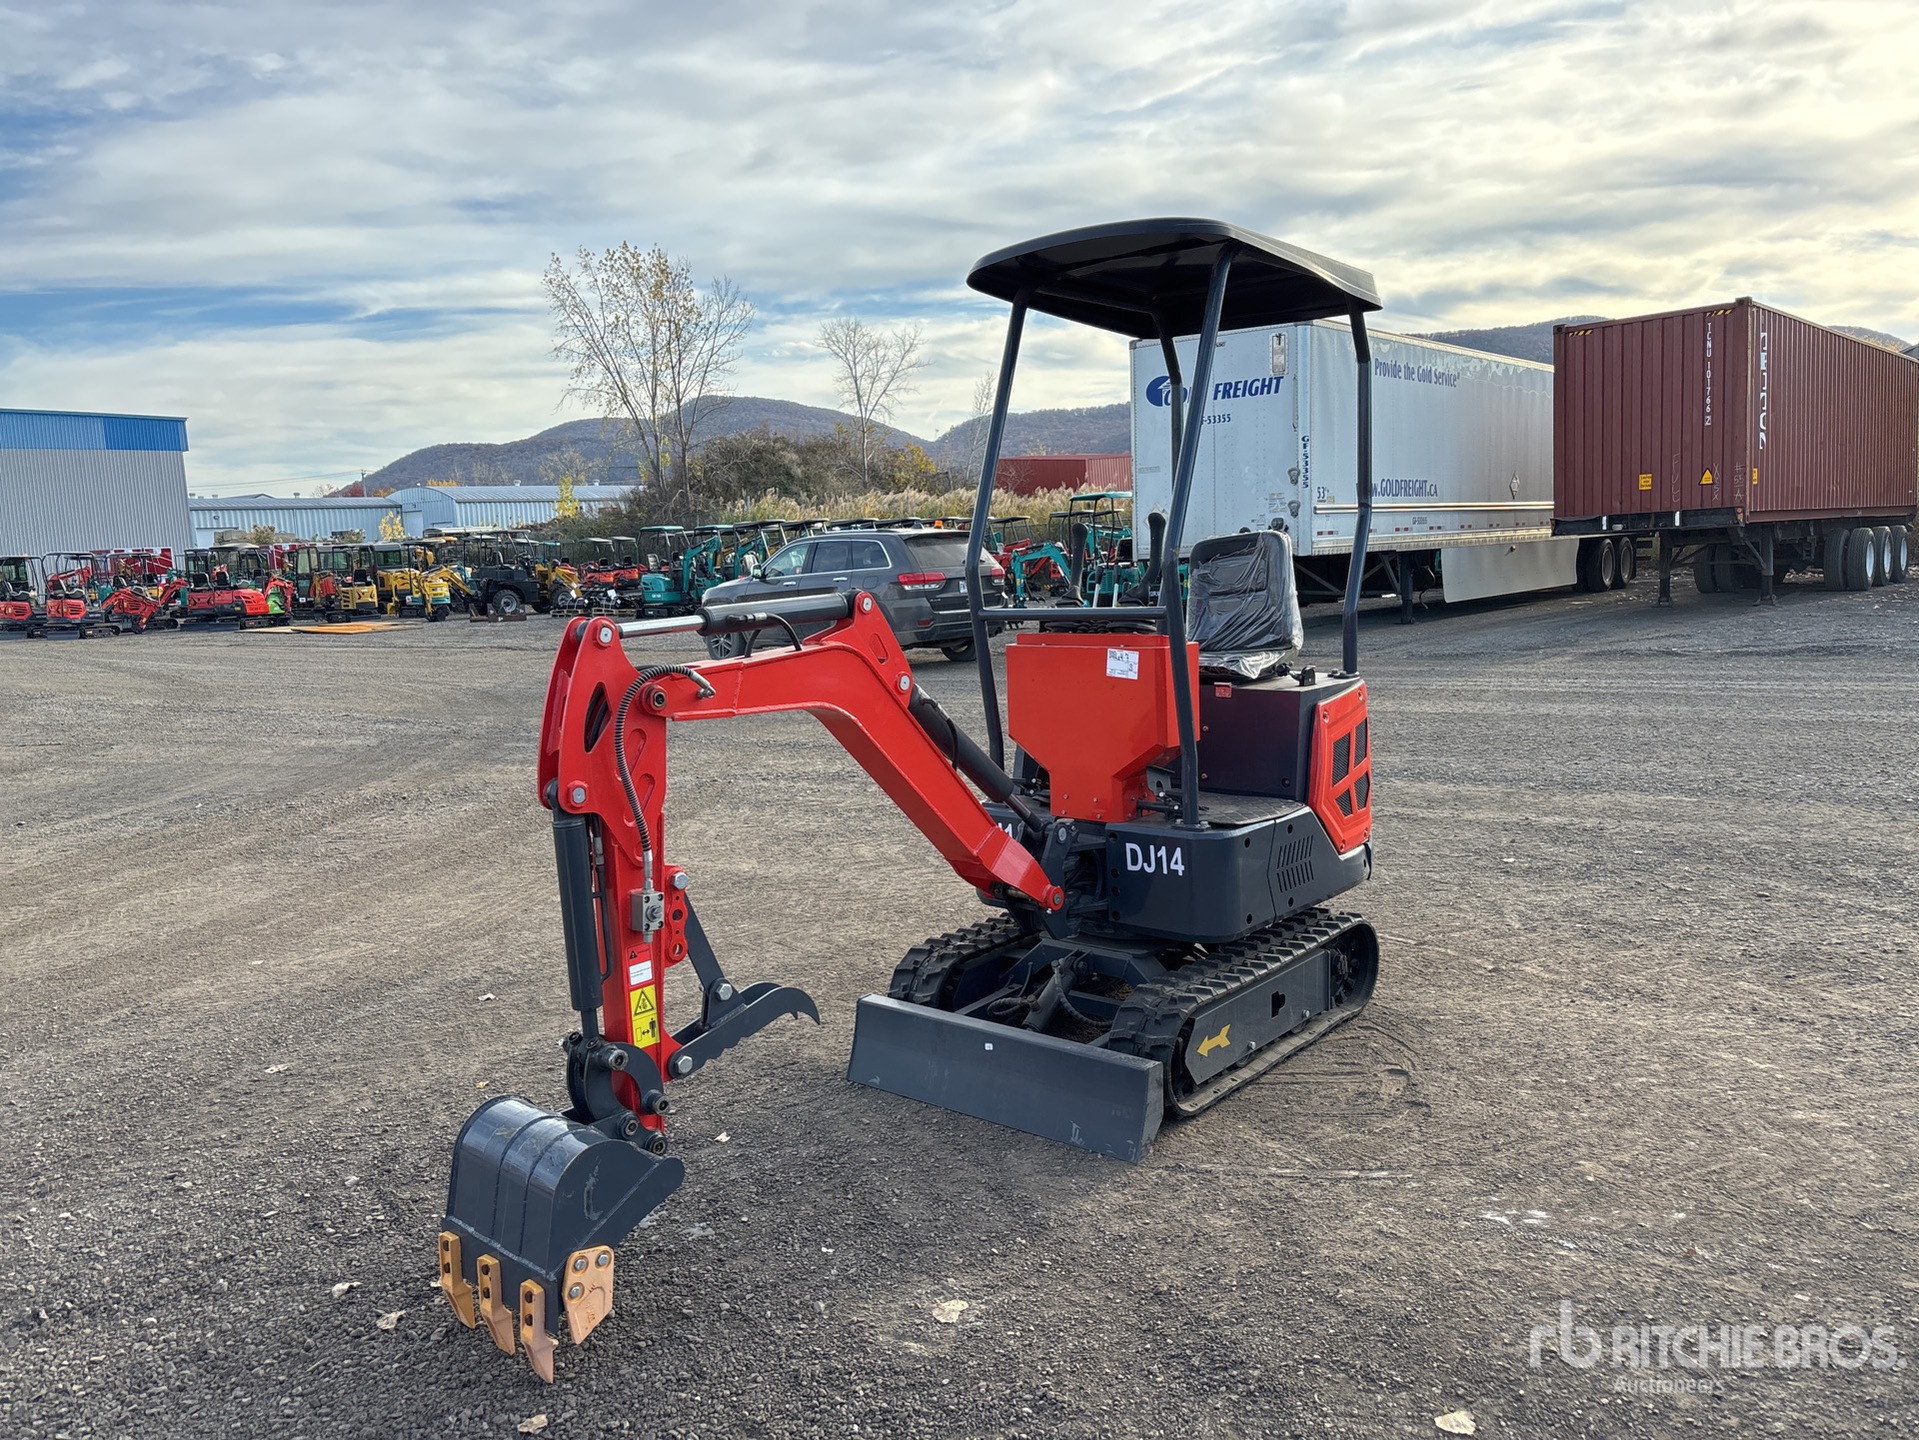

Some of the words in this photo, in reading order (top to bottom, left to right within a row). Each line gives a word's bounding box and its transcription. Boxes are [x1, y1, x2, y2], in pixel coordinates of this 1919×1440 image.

[1375, 358, 1402, 379] Provide
[1404, 362, 1415, 381] the
[1417, 366, 1433, 384] Gold
[1213, 376, 1284, 400] FREIGHT
[1301, 435, 1310, 489] GF-53355
[1125, 842, 1185, 876] DJ14
